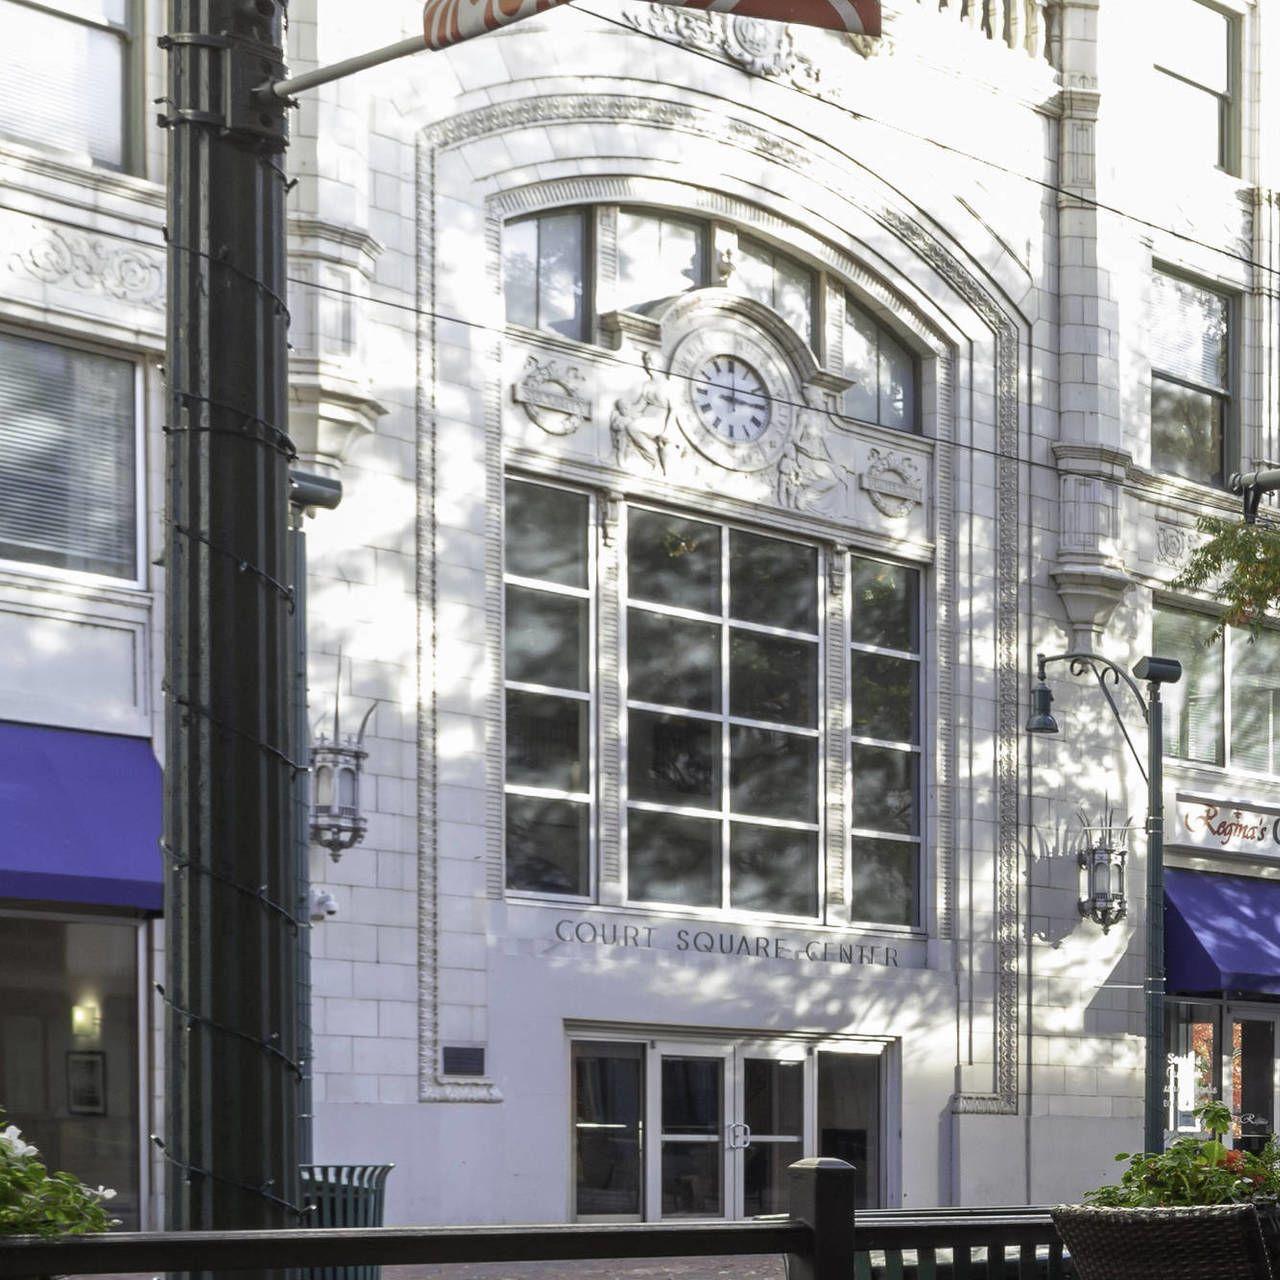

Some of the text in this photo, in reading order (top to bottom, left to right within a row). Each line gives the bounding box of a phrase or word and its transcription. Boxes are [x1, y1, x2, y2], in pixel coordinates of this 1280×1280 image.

[1184, 802, 1266, 845] Regina's
[555, 919, 899, 967] COURT SQUARE CENTER
